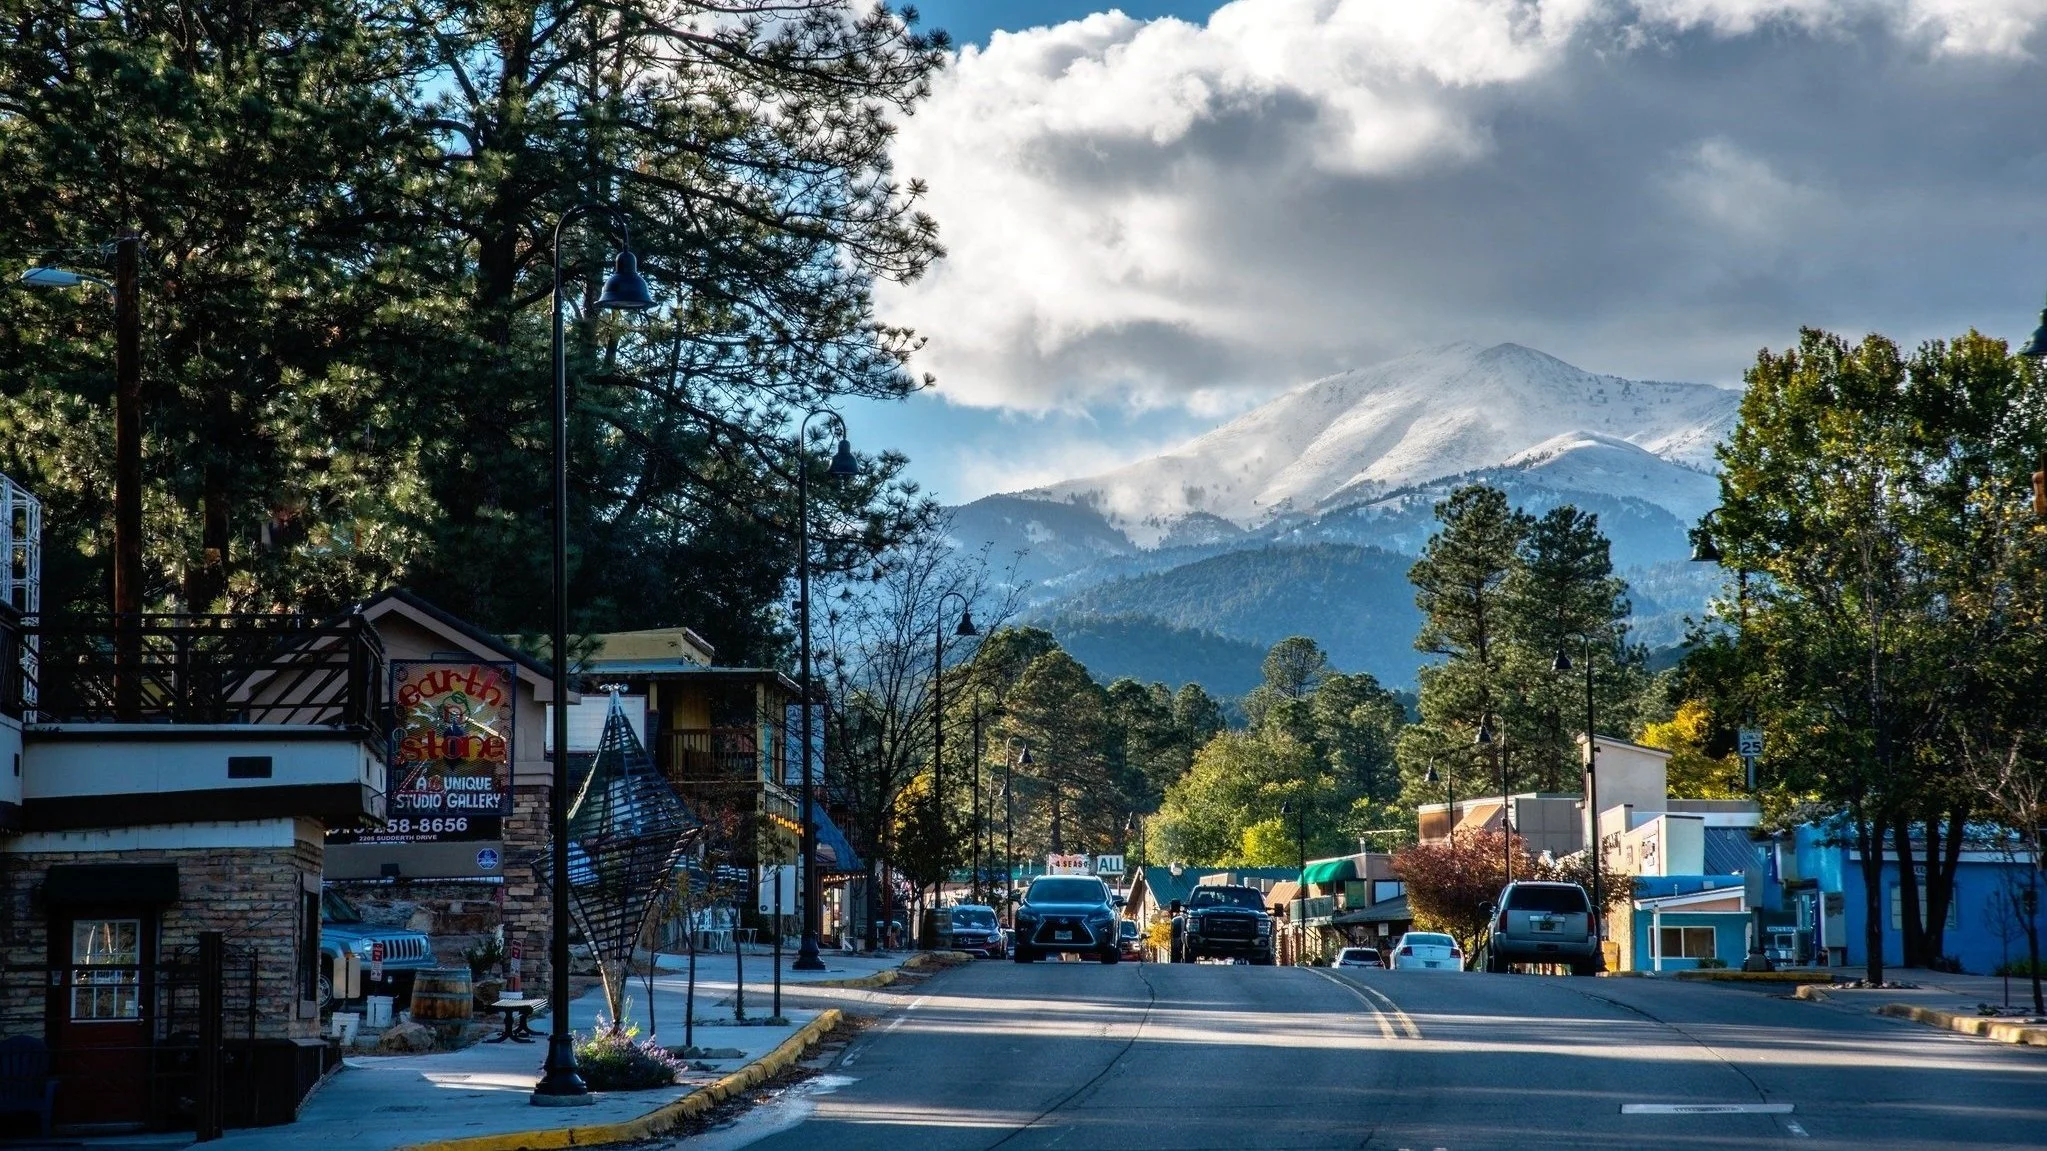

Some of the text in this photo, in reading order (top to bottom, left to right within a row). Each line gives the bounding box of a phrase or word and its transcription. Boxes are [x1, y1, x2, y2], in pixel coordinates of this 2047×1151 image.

[399, 665, 501, 706] earth
[400, 729, 506, 760] stone
[1741, 741, 1762, 754] 25
[443, 776, 492, 791] UNIQUE
[396, 792, 501, 809] STUDIO GALLERY
[1098, 857, 1123, 872] ALL
